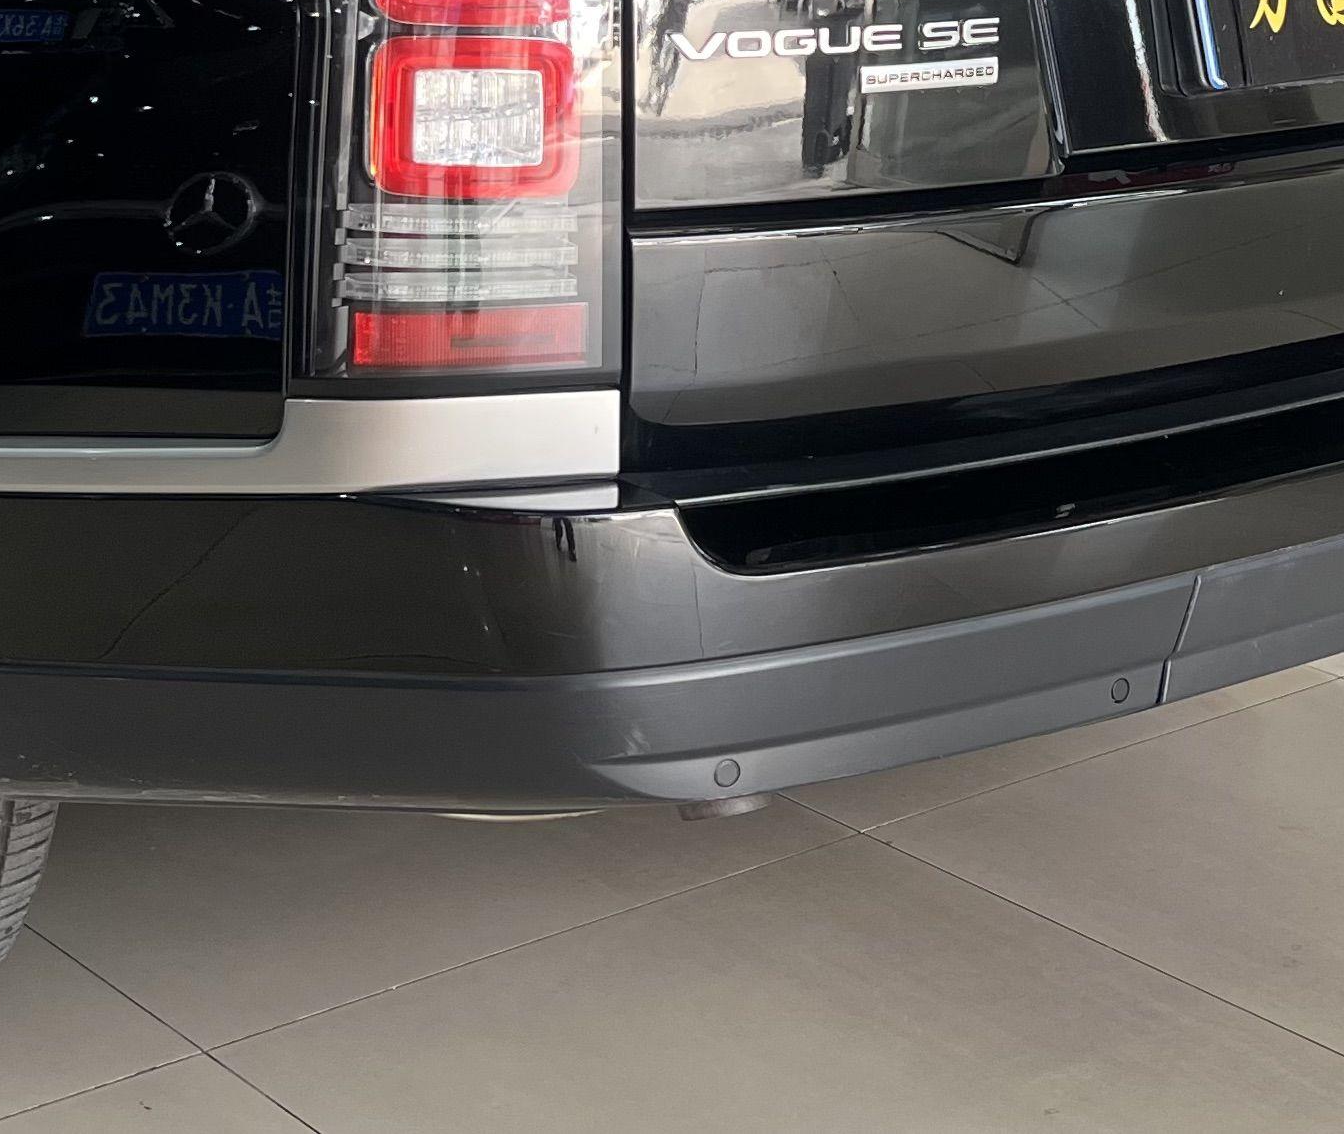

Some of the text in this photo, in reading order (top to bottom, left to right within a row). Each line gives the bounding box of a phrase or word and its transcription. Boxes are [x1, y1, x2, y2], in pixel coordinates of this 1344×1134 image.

[664, 17, 1001, 61] VOGUE SE
[865, 66, 996, 86] SUPERCHARGED
